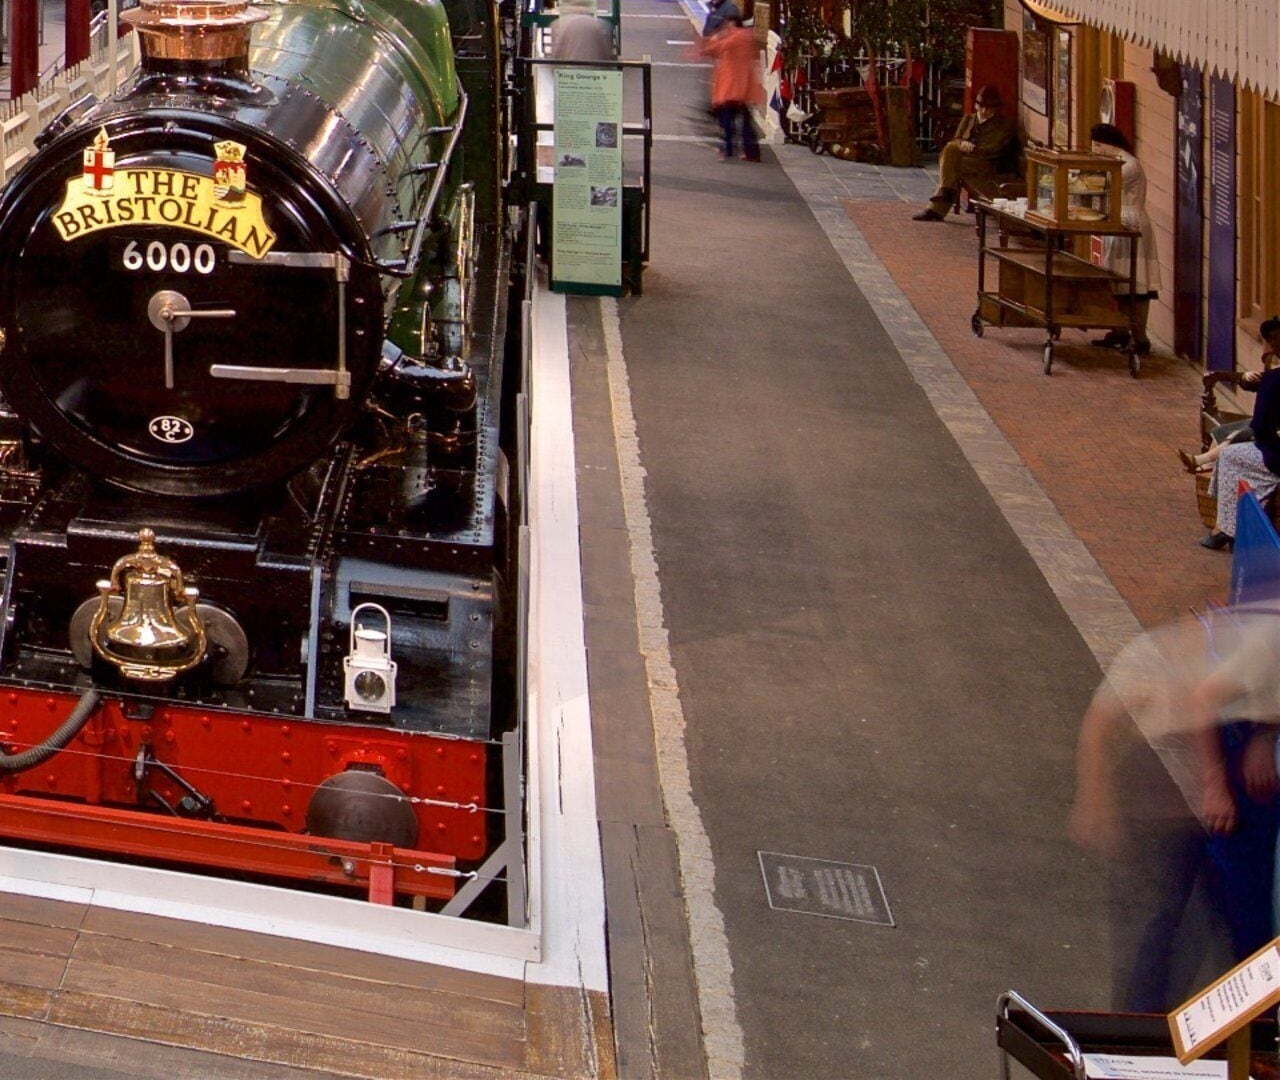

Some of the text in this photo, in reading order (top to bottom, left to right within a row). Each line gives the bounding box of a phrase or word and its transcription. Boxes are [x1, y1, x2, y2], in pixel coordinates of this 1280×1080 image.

[127, 171, 200, 201] THE
[57, 197, 273, 256] BRISTOLIAN
[123, 241, 216, 274] 6000
[161, 419, 181, 433] 82
[165, 432, 176, 441] C
